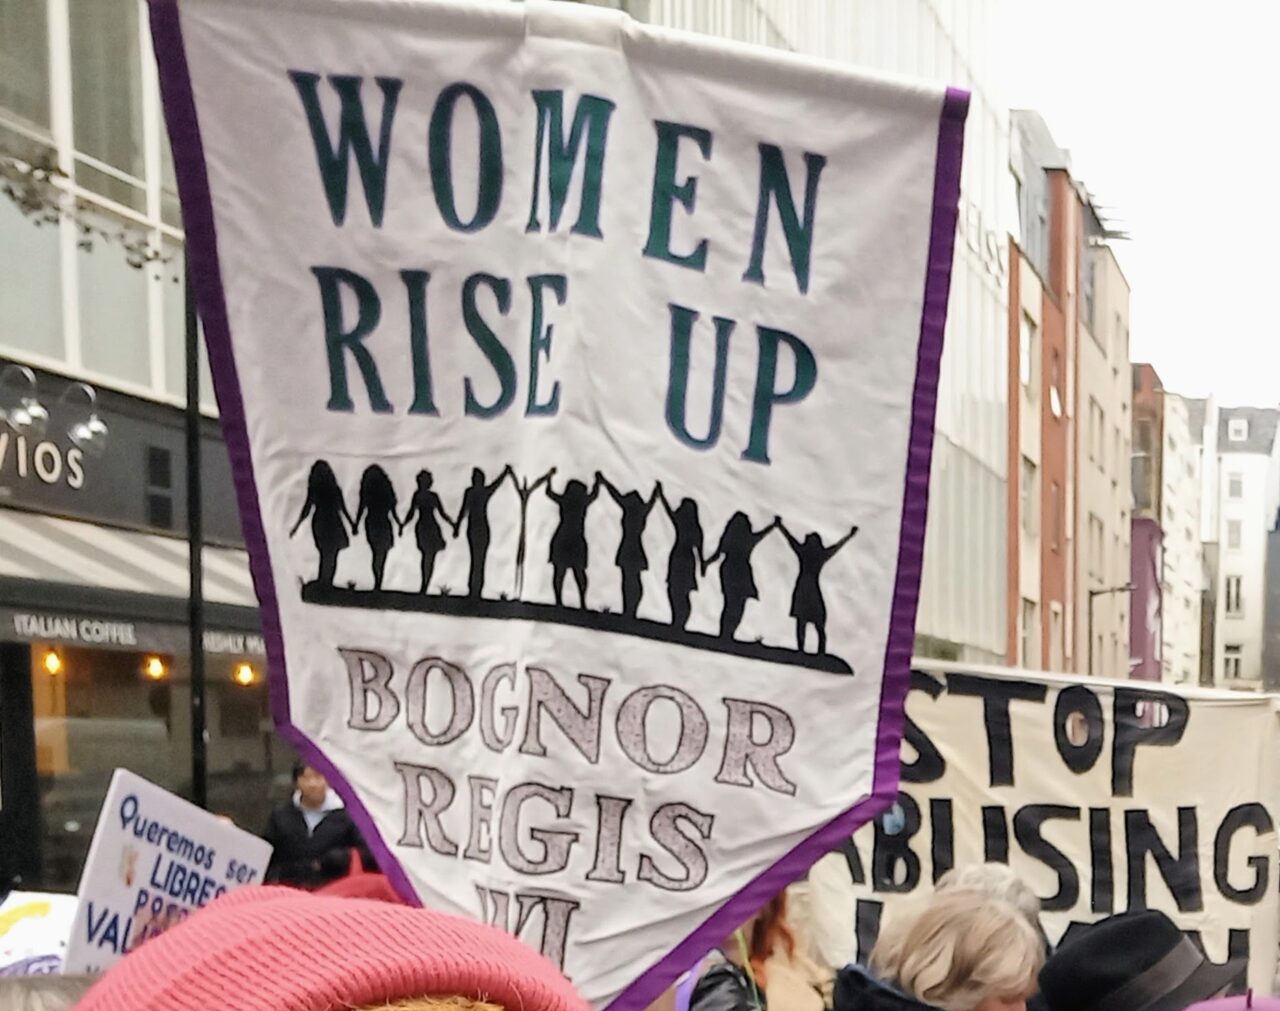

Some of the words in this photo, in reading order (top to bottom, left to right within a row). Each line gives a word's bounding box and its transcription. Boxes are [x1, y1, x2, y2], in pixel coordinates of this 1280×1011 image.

[287, 69, 827, 296] WOMEN
[310, 265, 568, 421] RISE
[664, 303, 818, 466] UP
[337, 646, 798, 797] BOGNOR
[900, 672, 1190, 798] STOP
[120, 795, 216, 870] Queremos
[225, 858, 257, 884] ser
[394, 760, 715, 892] REGIS
